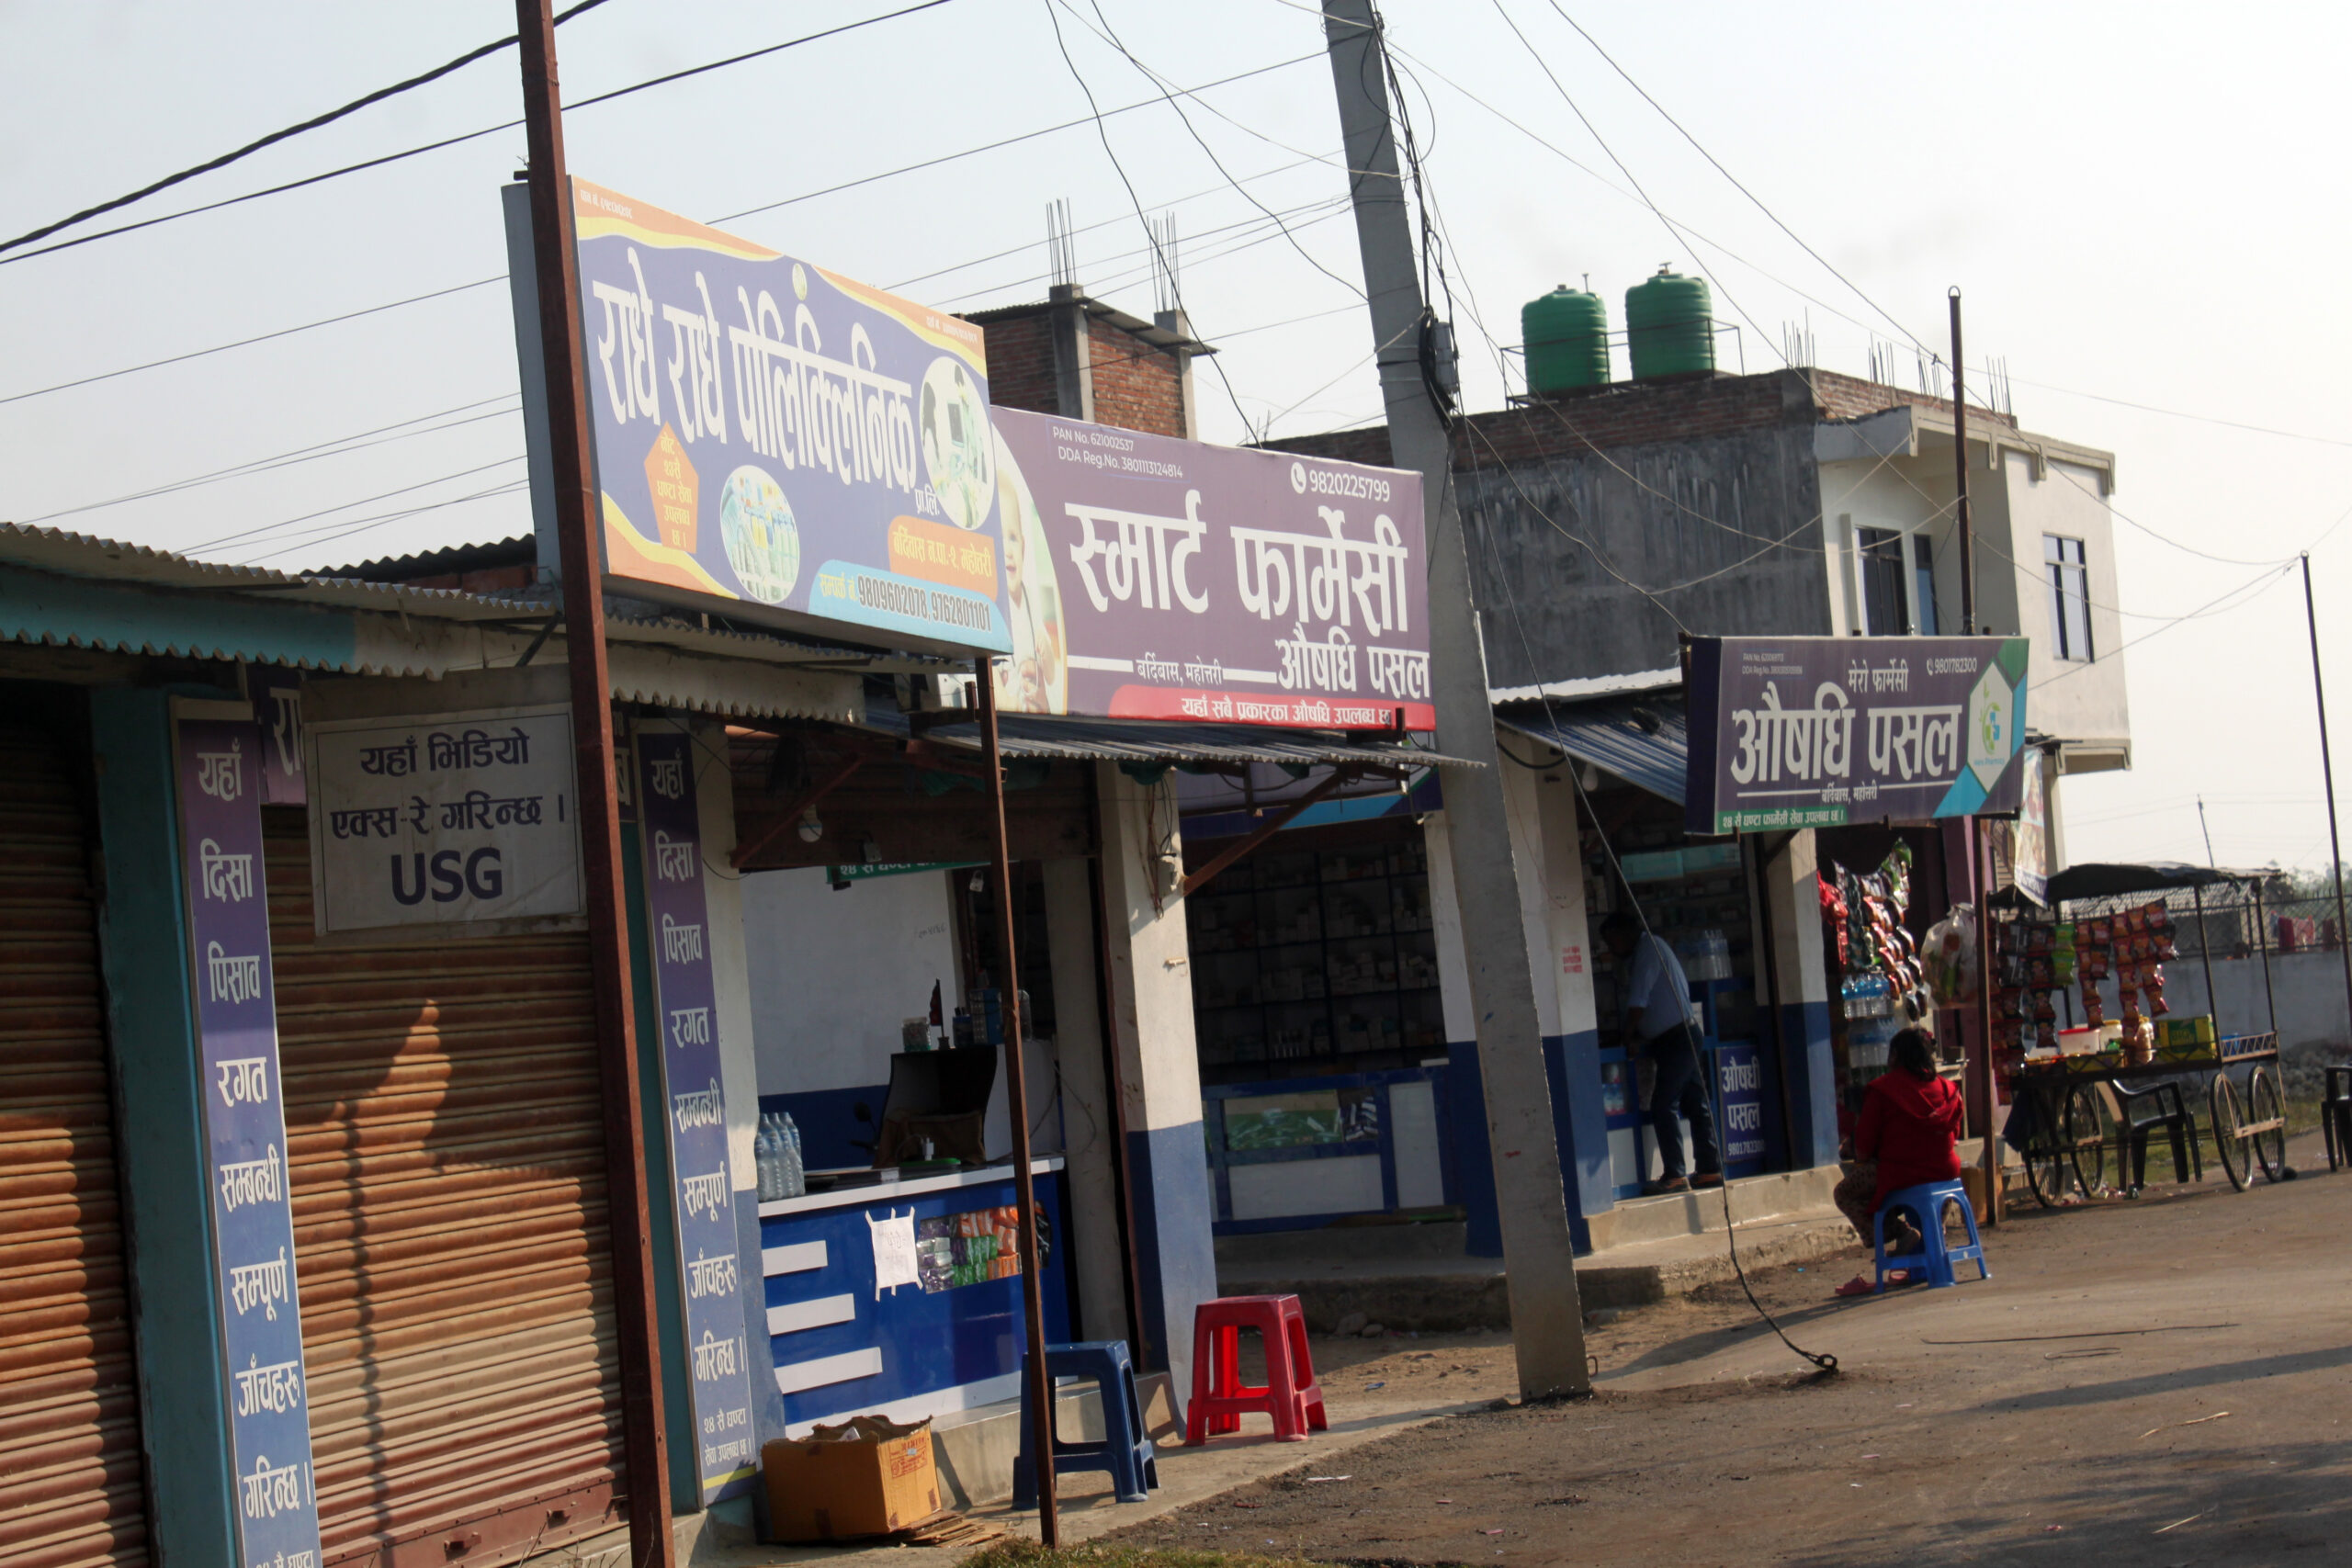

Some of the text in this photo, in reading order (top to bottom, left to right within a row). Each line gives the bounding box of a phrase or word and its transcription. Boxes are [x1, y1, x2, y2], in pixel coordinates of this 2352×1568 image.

[592, 246, 661, 425] राधे
[662, 271, 727, 445] राधे
[1052, 426, 1134, 452] PAN No. 621002537
[1058, 446, 1081, 462] DDA
[1309, 469, 1390, 503] 9820225799
[1064, 489, 1408, 637] स्मार्ट फार्मेसी
[932, 592, 992, 633] 9762801101
[1275, 621, 1430, 700] औषधि पसल
[1849, 658, 1908, 694] मेरो फार्मेसी
[1934, 657, 1977, 674] 9801782300
[1182, 694, 1208, 717] यहाँ
[1212, 694, 1233, 718] सबै
[1292, 699, 1330, 724] औषधि
[1730, 680, 1962, 784] औषधि पसल
[197, 737, 243, 801] यहाँ
[359, 727, 530, 777] यहाँ भिडियो
[650, 746, 684, 800] यहाँ
[440, 790, 543, 830] गरिन्छ
[199, 837, 254, 903] दिसा
[390, 846, 503, 906] USG
[655, 829, 695, 883] दिसा
[662, 912, 703, 965] पिसाव
[207, 940, 262, 1005] पिसाव
[671, 1006, 710, 1049] रगत
[215, 1055, 268, 1108] रगत
[674, 1077, 722, 1134] सम्बन्धी
[1727, 1101, 1761, 1132] पसल
[220, 1143, 282, 1213] सम्बन्धी
[683, 1160, 728, 1223] सम्पूर्ण
[230, 1247, 289, 1322] सम्पूर्ण
[694, 1329, 737, 1382] गरिन्छ
[704, 1416, 715, 1433] २४
[726, 1407, 746, 1427] घण्टा
[243, 1454, 300, 1520] गरिन्छ
